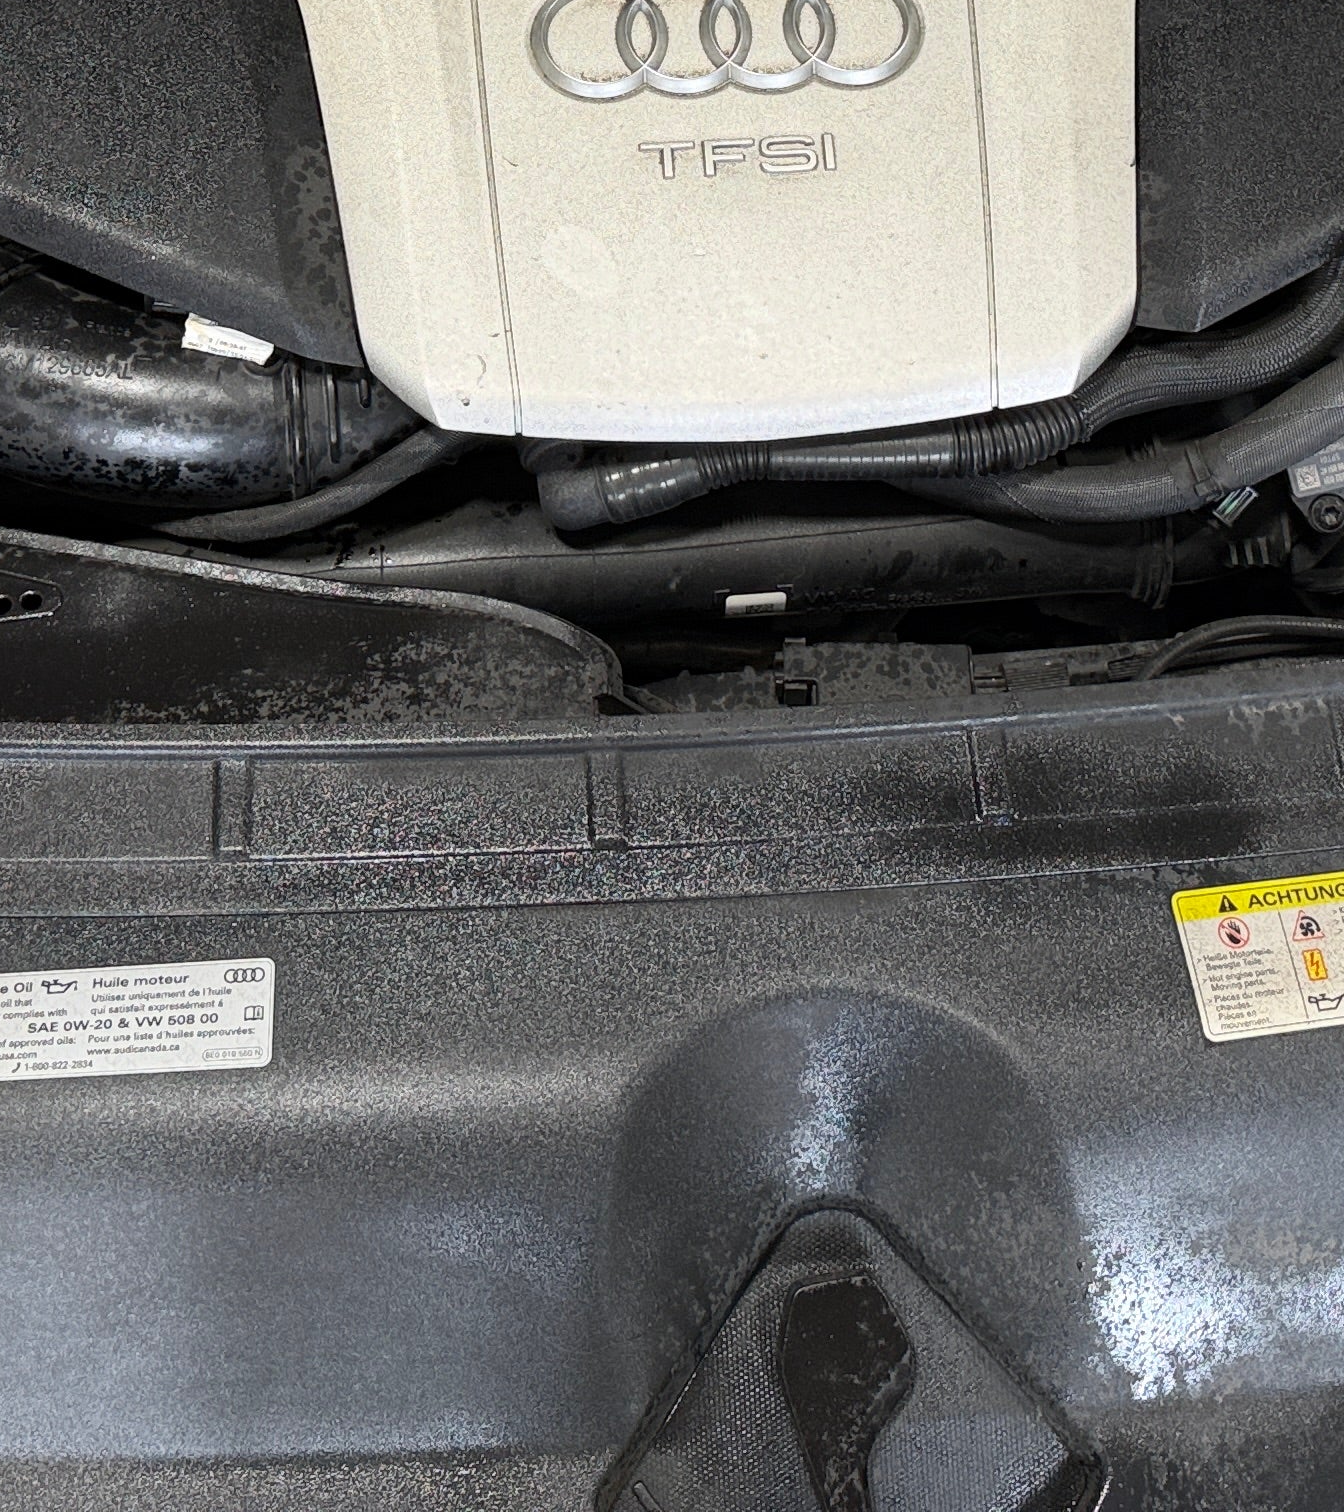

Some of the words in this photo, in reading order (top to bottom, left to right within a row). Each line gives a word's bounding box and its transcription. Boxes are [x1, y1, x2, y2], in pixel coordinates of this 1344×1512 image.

[638, 132, 837, 180] TFSI
[93, 977, 129, 988] Huile
[134, 975, 189, 986] moteur
[1225, 972, 1253, 982] engine
[14, 982, 33, 993] Oil
[188, 988, 200, 997] de
[1, 999, 12, 1008] oil
[15, 998, 32, 1007] that
[3, 1010, 45, 1020] complies
[48, 1008, 67, 1017] with
[90, 1006, 105, 1016] qui
[28, 1022, 58, 1033] SAE
[64, 1019, 112, 1031] 0W-20
[118, 1018, 129, 1028] &
[135, 1016, 163, 1027] VW
[168, 1014, 195, 1025] 508
[200, 1013, 218, 1023] 00
[9, 1037, 54, 1049] approved
[88, 1035, 110, 1043] Pour
[134, 1032, 153, 1041] liste
[87, 1044, 180, 1055] www.audicanada.ca
